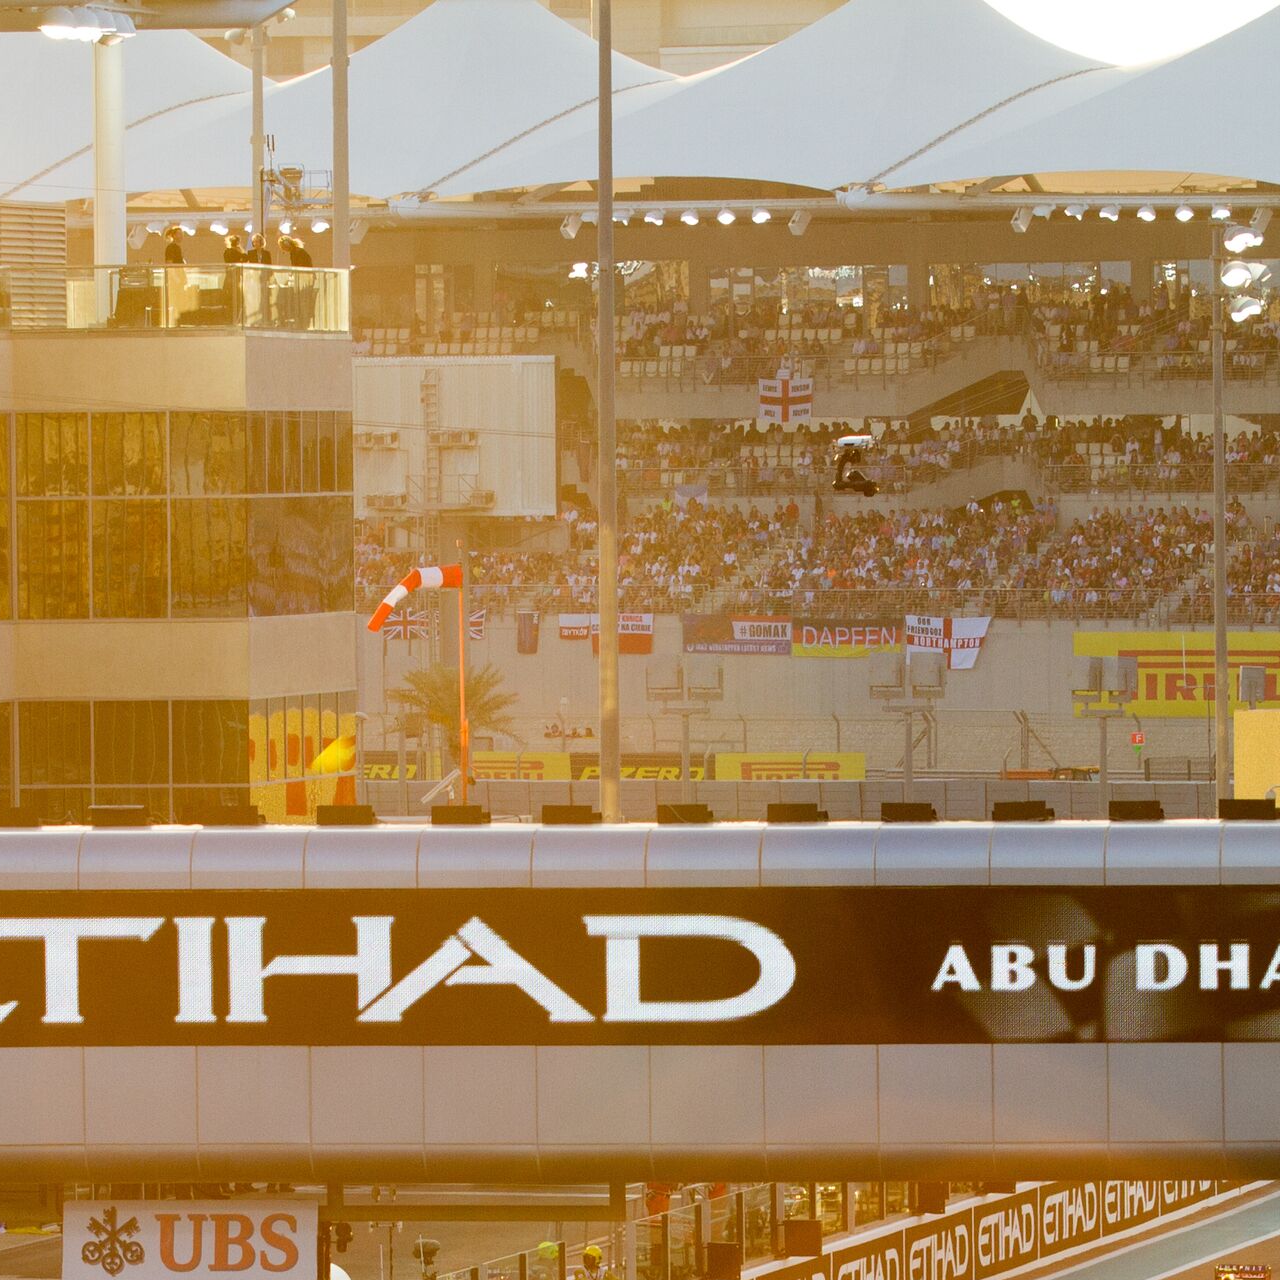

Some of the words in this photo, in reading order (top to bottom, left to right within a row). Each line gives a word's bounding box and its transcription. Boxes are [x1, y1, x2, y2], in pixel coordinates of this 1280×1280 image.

[913, 636, 980, 648] NORTHAMPTON
[932, 944, 1096, 992] ABU
[1042, 1182, 1098, 1245] ETIHAD
[1104, 1180, 1157, 1224] ETIHAD
[154, 1213, 300, 1273] UBS
[977, 1203, 1035, 1267] ETIHAD
